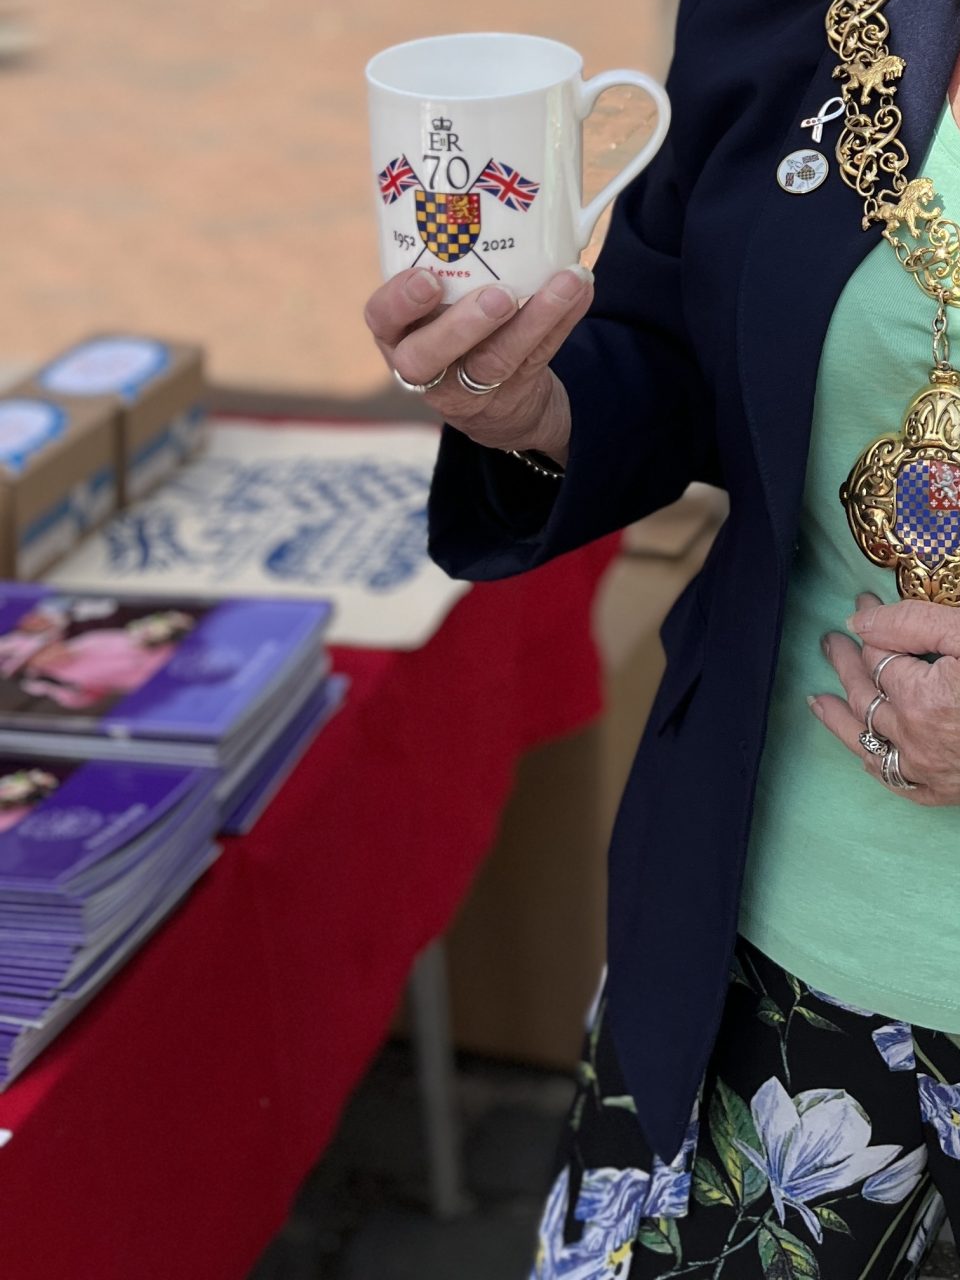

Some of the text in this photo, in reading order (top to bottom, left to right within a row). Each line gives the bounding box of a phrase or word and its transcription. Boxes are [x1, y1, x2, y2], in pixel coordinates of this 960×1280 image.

[422, 154, 470, 190] 70
[393, 230, 416, 250] 1952
[482, 238, 515, 252] 2022
